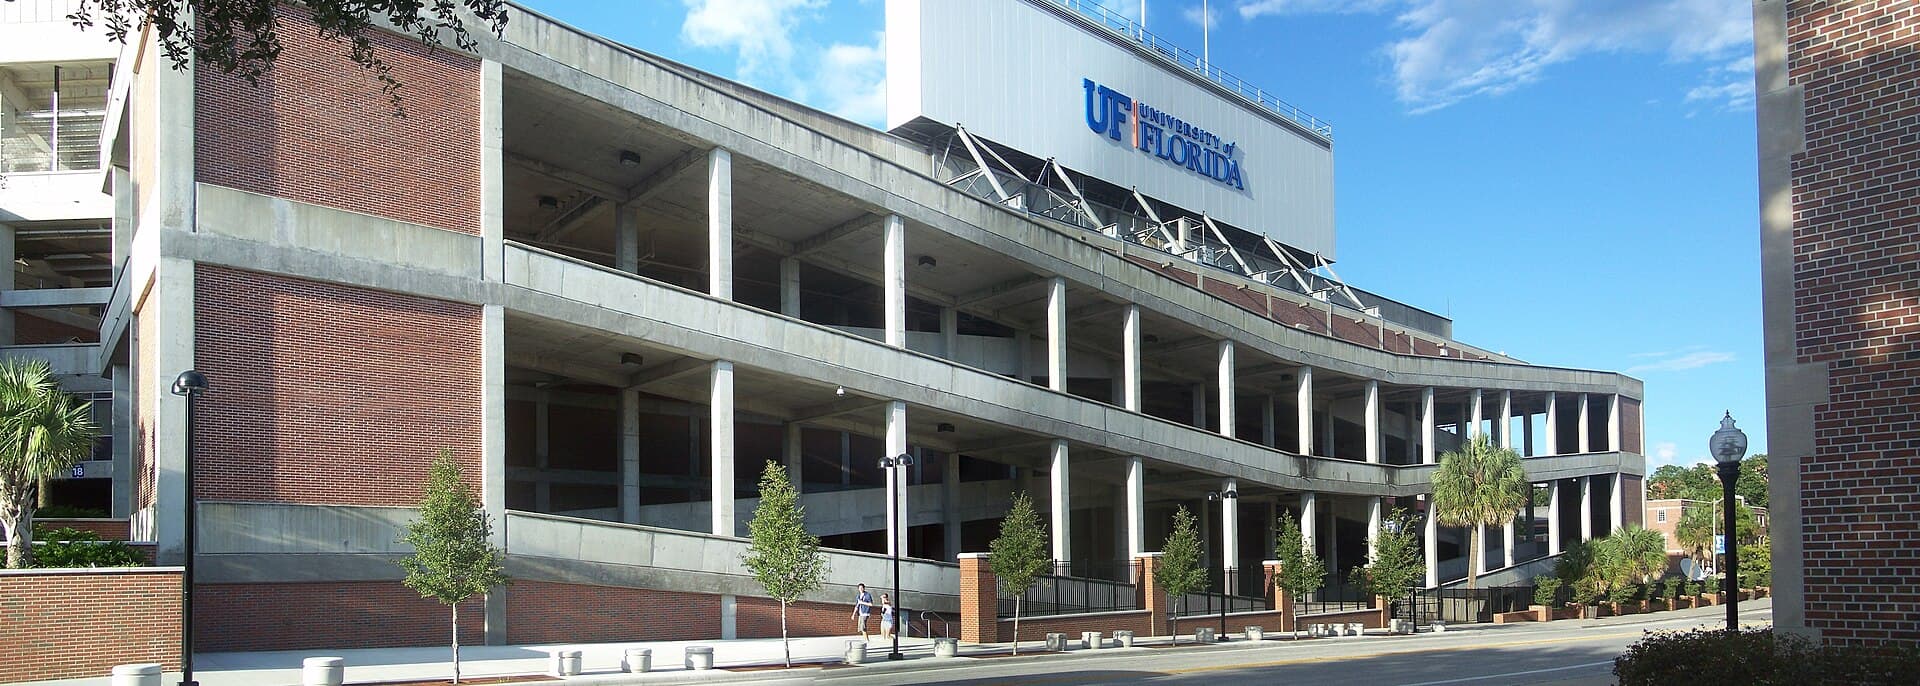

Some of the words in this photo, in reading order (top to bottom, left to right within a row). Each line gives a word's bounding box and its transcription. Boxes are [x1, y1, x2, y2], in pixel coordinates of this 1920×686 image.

[1083, 77, 1132, 142] UF
[1139, 102, 1221, 149] UNIVERSITY
[1222, 141, 1236, 158] of
[1139, 120, 1244, 190] FLORIDA
[72, 467, 84, 476] 18
